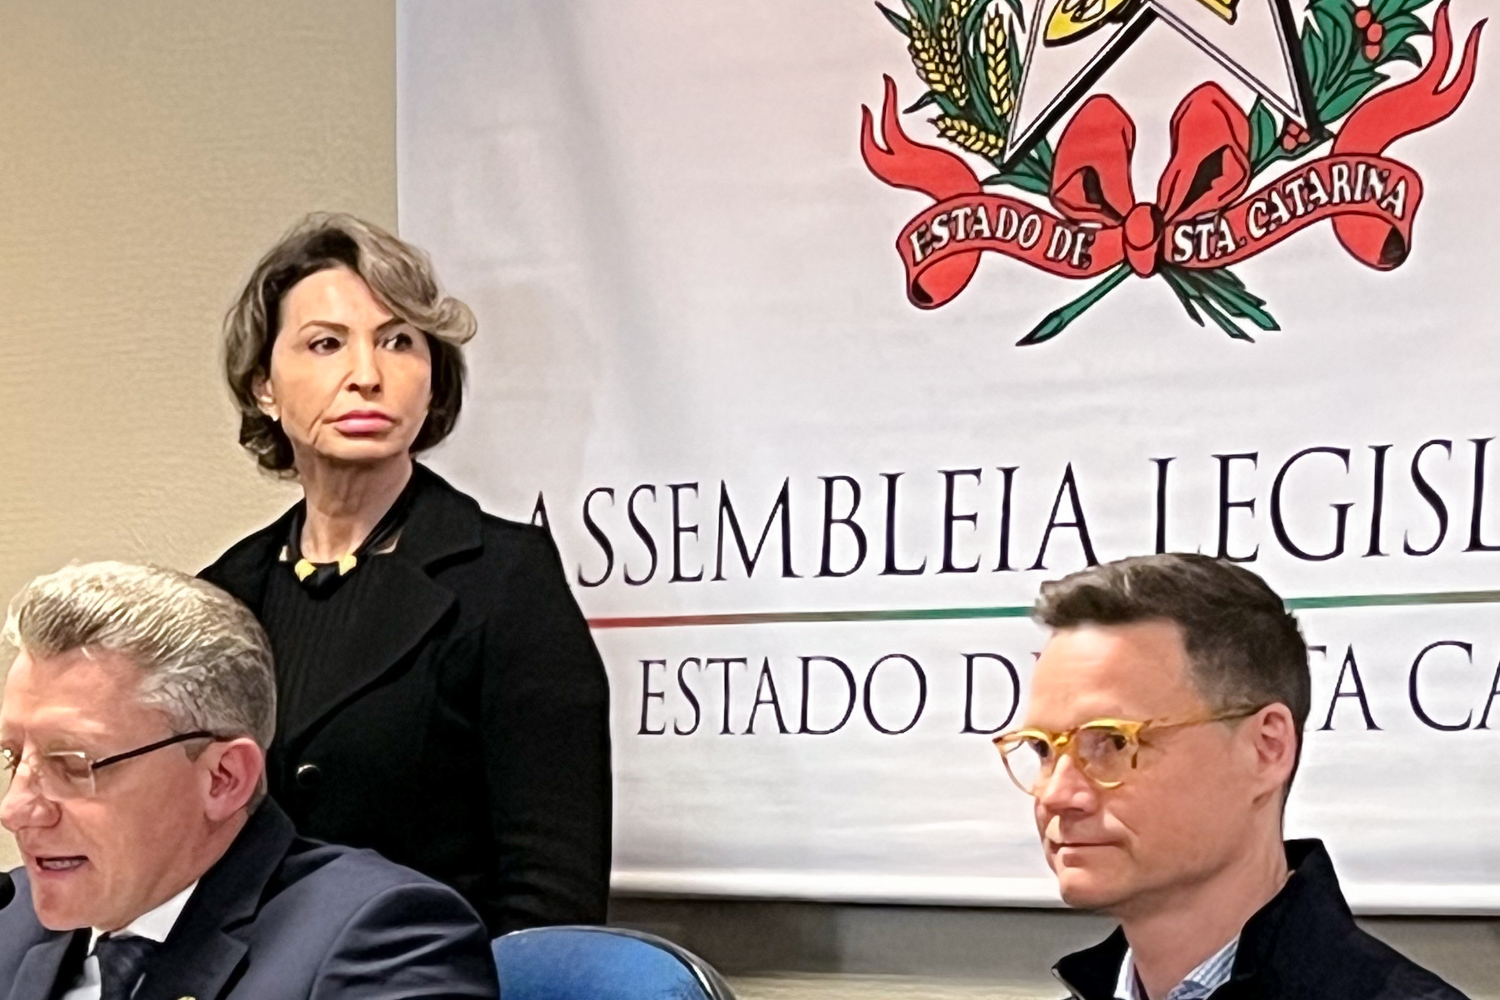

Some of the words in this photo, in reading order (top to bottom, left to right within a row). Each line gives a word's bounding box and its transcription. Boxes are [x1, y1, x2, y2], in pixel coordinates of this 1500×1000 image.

[909, 205, 1042, 264] ESTADO
[1045, 225, 1096, 268] DE
[1248, 162, 1407, 241] CATARINA
[637, 653, 927, 735] ESTADO
[959, 651, 1041, 735] D
